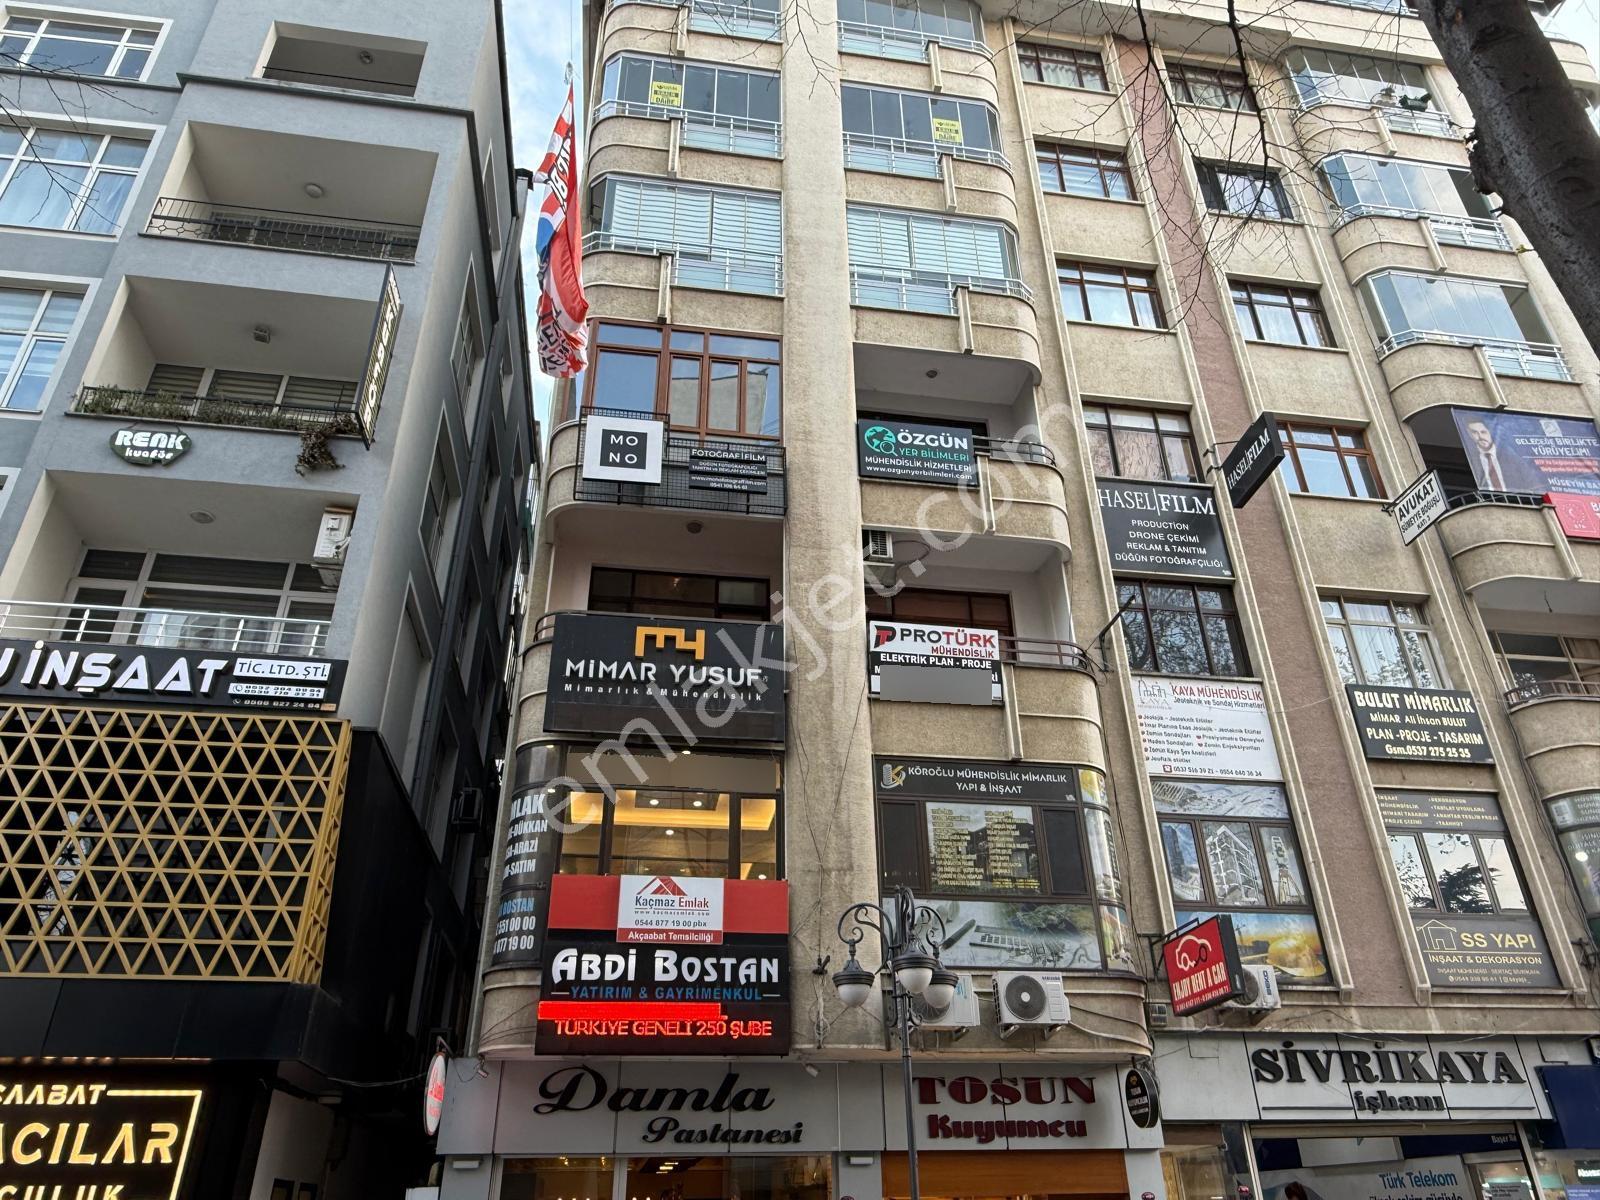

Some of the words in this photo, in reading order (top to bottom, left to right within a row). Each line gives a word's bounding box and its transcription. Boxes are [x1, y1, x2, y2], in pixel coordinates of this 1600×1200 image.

[114, 430, 187, 450] RENK
[610, 434, 639, 447] MO
[897, 429, 968, 450] ÖZGÜN
[609, 452, 638, 464] NO
[899, 447, 918, 457] YER
[865, 456, 923, 468] MÜHENDİSLİK
[1098, 488, 1156, 510] HASEL
[1158, 493, 1216, 515] FILM
[1398, 478, 1435, 522] AVUKAT
[1129, 531, 1165, 541] DRONE
[1167, 533, 1200, 544] ÇEKİMİ
[1126, 542, 1162, 552] REKLAM
[1172, 545, 1207, 555] TANITIM
[1115, 552, 1148, 563] DÜĞÜN
[900, 628, 996, 649] PROTÜRK
[931, 645, 995, 659] MÜHENDİSLİK
[21, 640, 229, 694] İNŞAAT
[880, 653, 928, 664] ELEKTRİK
[929, 656, 954, 667] PLAN
[962, 658, 992, 669] PROJE
[269, 664, 299, 676] LTD.
[565, 657, 657, 683] MİMAR
[670, 664, 763, 687] YUSUF
[1171, 685, 1196, 697] KAYA
[1197, 685, 1263, 701] MÜHENDİSLİK
[1353, 690, 1401, 709] BULUT
[1403, 691, 1476, 714] MİMARLIK
[1370, 711, 1401, 724] MİMAR
[1442, 716, 1468, 727] BULUT
[1366, 728, 1394, 740] PLAN
[1438, 731, 1484, 745] TASARIM
[1428, 746, 1446, 757] 275
[1447, 747, 1459, 757] 25
[908, 765, 955, 778] KÖROĞLU
[956, 767, 1020, 782] MÜHENDİSLİK
[1021, 771, 1067, 783] MİMARLIK
[956, 782, 978, 792] YAPI
[979, 784, 987, 792] &
[989, 783, 1023, 795] İNŞAAT
[635, 895, 675, 909] Kaçmaz
[678, 896, 709, 909] Emlak
[522, 915, 536, 931] 00
[508, 935, 519, 951] 19
[519, 934, 535, 950] 00
[628, 930, 667, 941] Akçaabat
[668, 931, 714, 943] Temsilciliği
[1460, 932, 1488, 948] SS
[1489, 933, 1537, 949] YAPI
[654, 949, 779, 985] BOSTAN
[1428, 953, 1463, 965] İNŞAAT
[1466, 955, 1474, 963] &
[1475, 955, 1542, 965] DEKORASYON
[1206, 967, 1213, 988] A
[1211, 961, 1227, 985] CAR
[571, 986, 633, 999] YATIRIM
[638, 987, 648, 999] &
[696, 1019, 727, 1036] 250
[730, 1020, 773, 1039] ŞUBE
[1251, 1040, 1527, 1085] SİVRİKAYA
[533, 1064, 775, 1115] Damla
[912, 1075, 1096, 1105] TOSUN
[641, 1116, 803, 1144] Pastanesi
[927, 1114, 1088, 1144] Kuyumcu
[1379, 1171, 1407, 1190] Türk
[1405, 1169, 1458, 1189] Telekom
